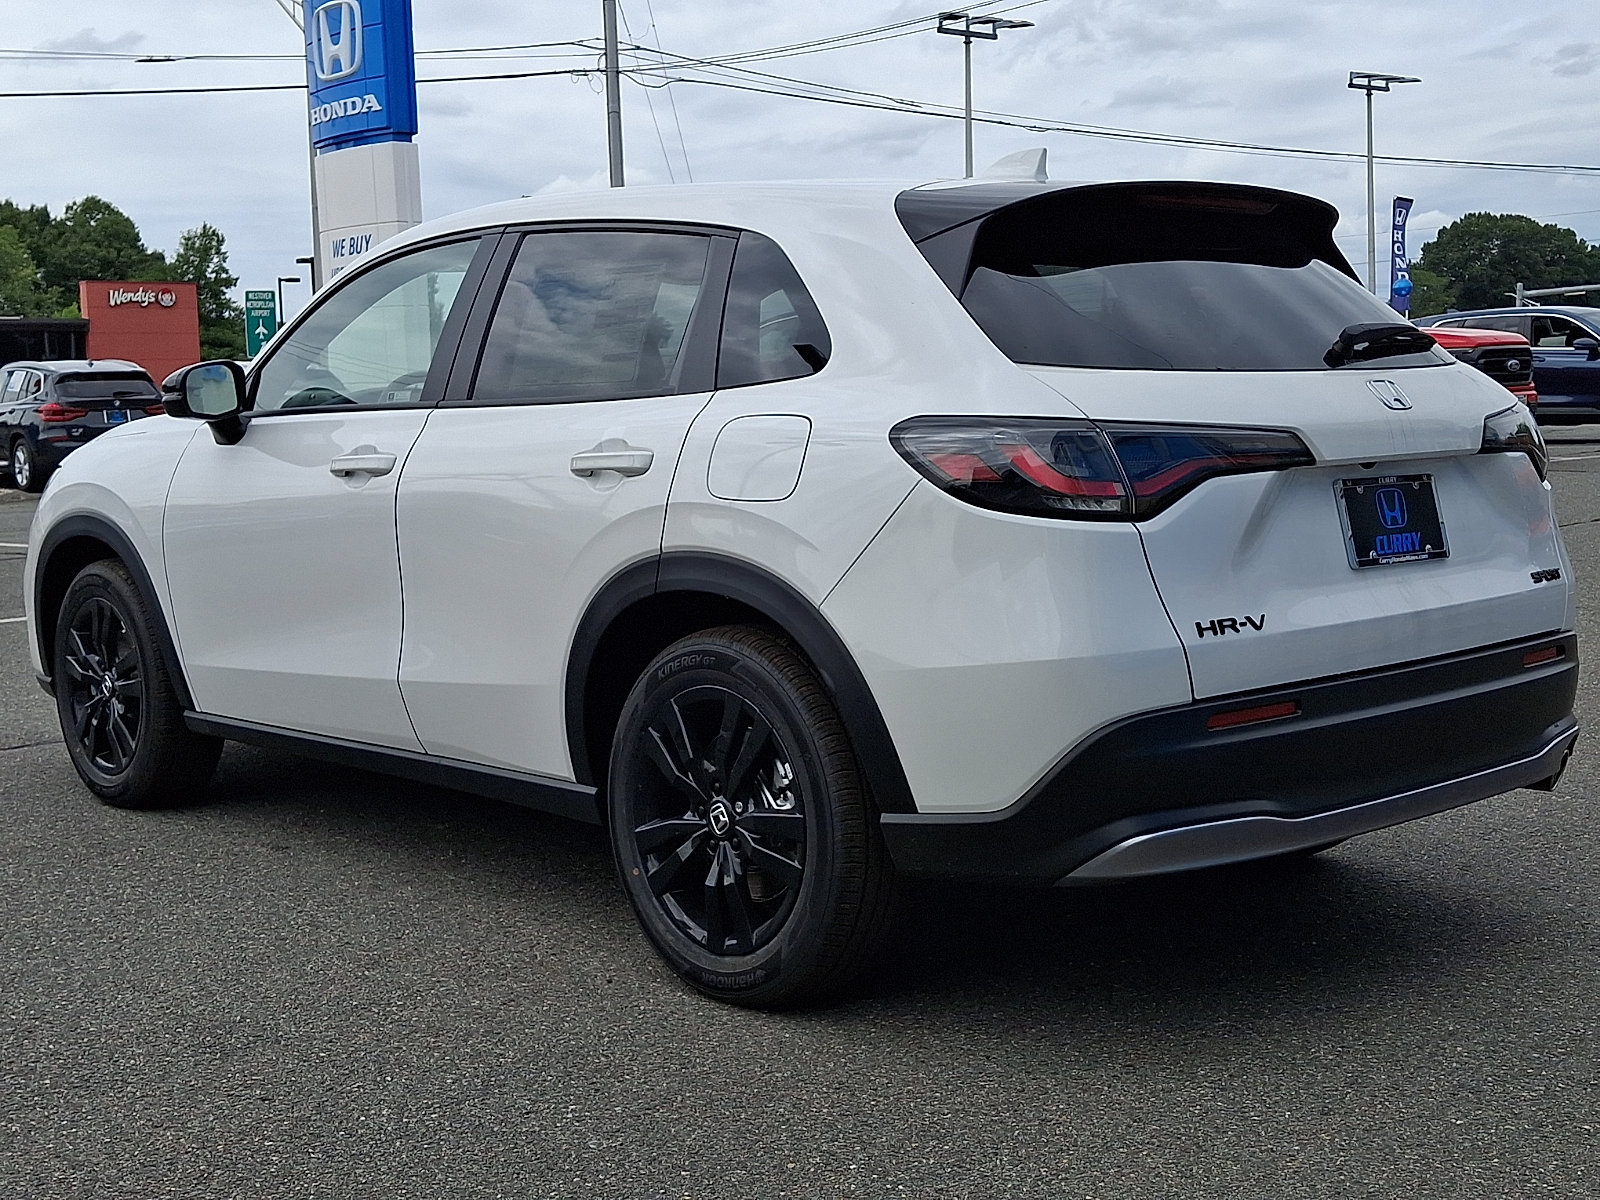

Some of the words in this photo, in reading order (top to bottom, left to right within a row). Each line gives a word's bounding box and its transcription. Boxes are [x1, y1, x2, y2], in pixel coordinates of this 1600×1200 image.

[311, 94, 382, 126] HONDA
[333, 239, 346, 258] WE
[349, 234, 372, 255] BUY
[1393, 230, 1409, 297] HOND
[109, 287, 155, 306] Wendy's
[1376, 532, 1420, 554] CURRY
[1530, 567, 1561, 584] SPORT
[1195, 613, 1265, 638] HR-V
[658, 654, 702, 680] KINERGY
